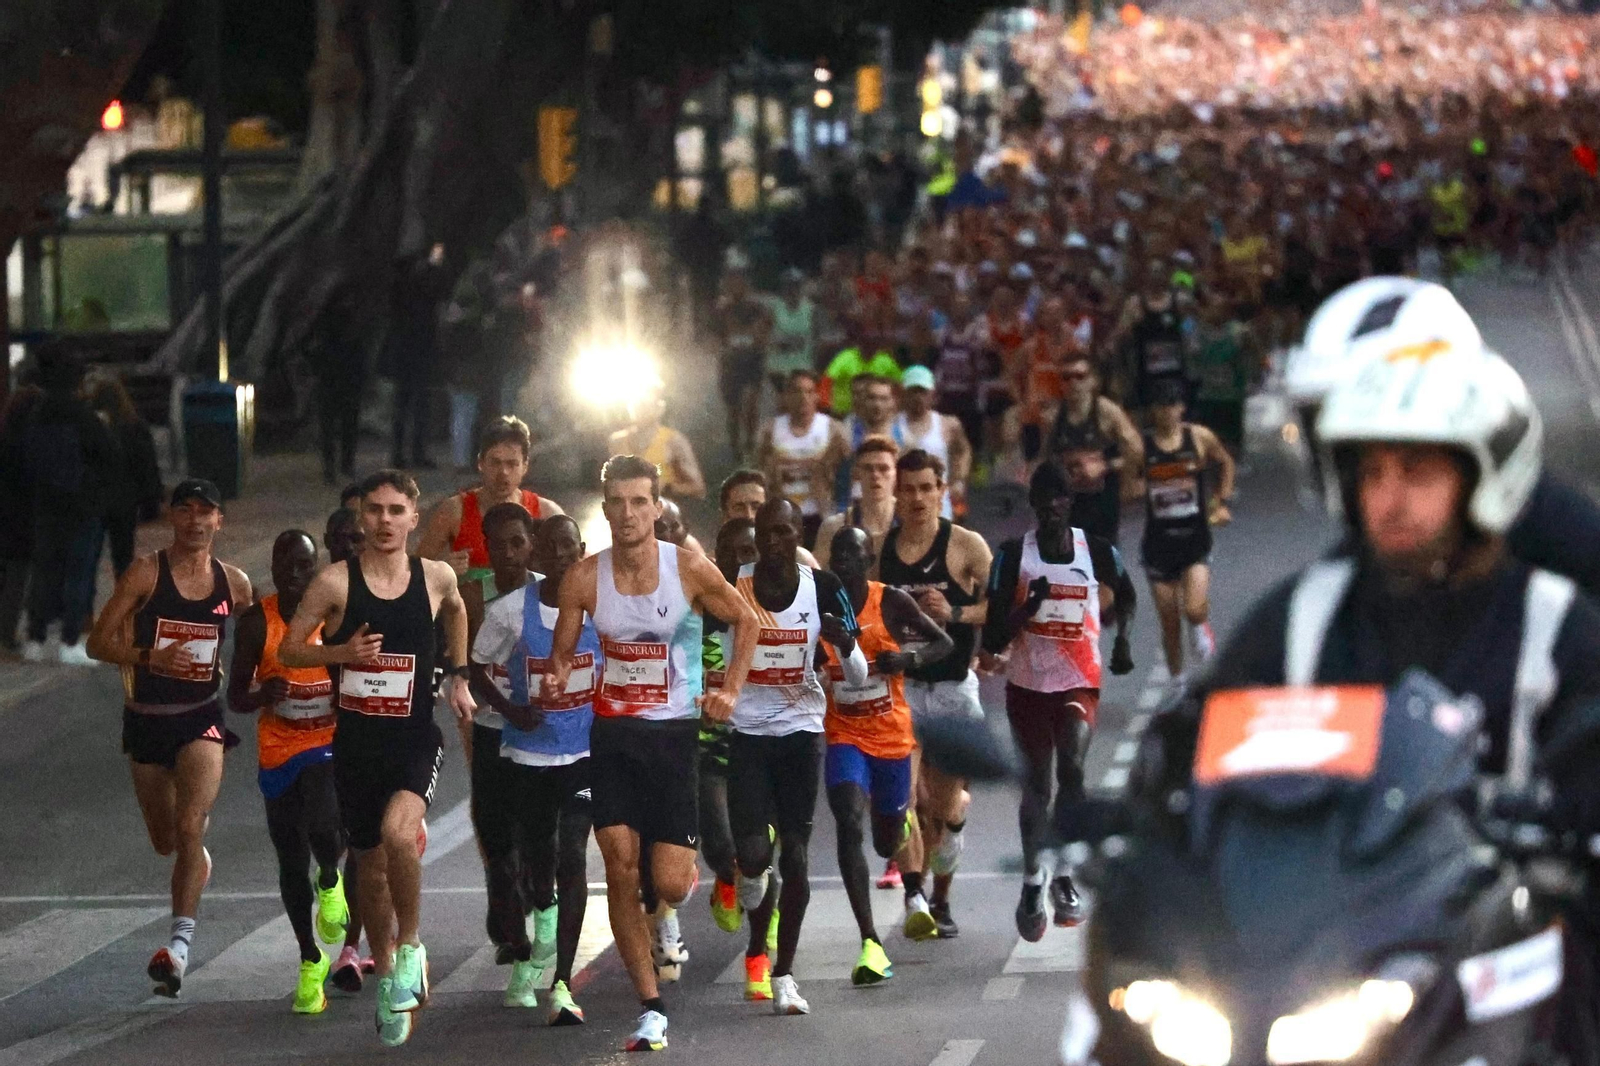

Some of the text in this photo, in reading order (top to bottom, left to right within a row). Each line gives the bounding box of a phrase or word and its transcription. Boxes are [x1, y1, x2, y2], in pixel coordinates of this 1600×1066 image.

[760, 630, 805, 640] GENERALI
[616, 645, 662, 655] GENERALI
[364, 678, 387, 687] PACER
